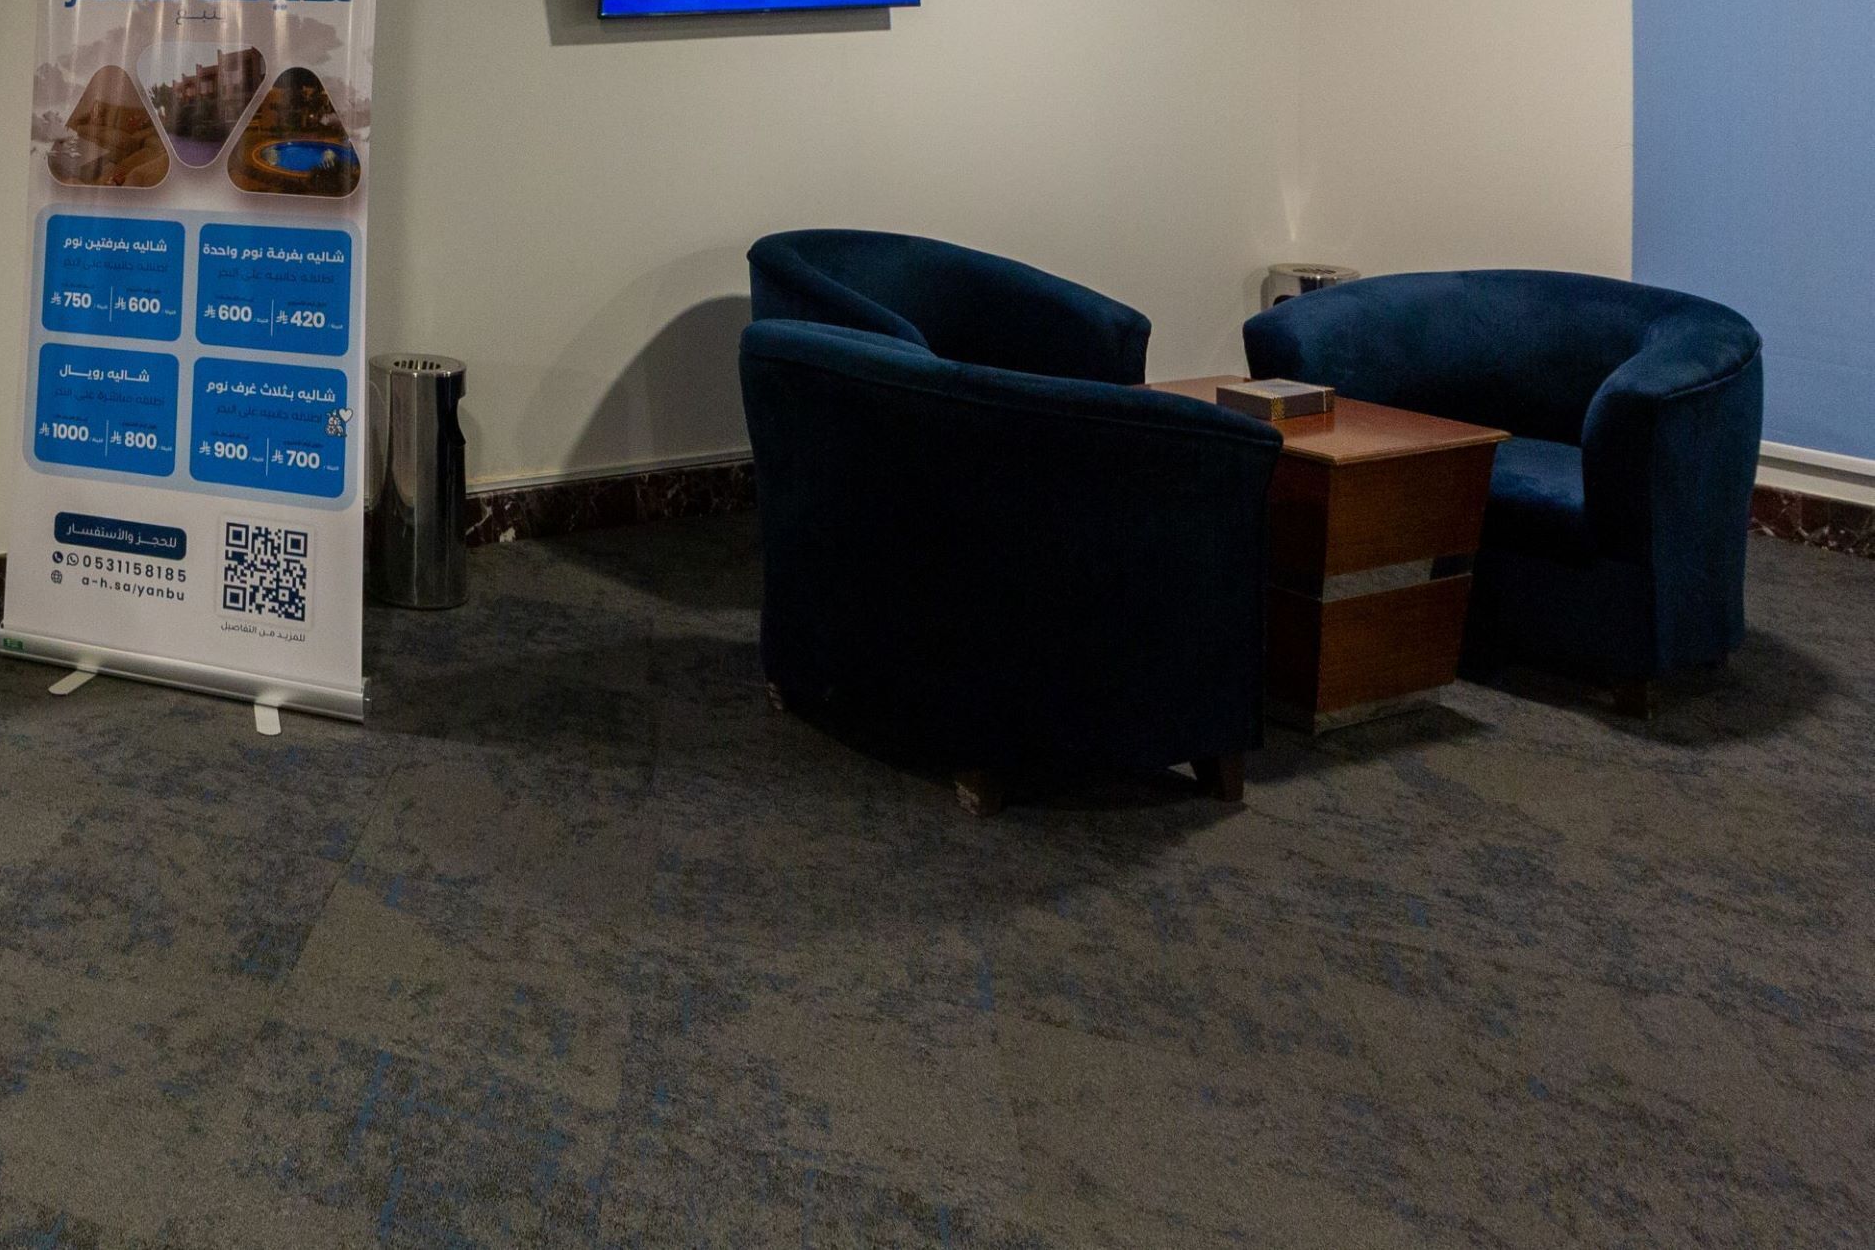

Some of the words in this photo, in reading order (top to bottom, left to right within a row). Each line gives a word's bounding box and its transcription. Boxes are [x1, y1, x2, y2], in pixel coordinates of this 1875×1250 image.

[63, 236, 83, 248] نوم
[85, 237, 130, 252] بغرفتين
[132, 238, 167, 254] شاليه
[202, 243, 238, 259] واحدة
[240, 247, 263, 260] نوم
[266, 246, 303, 263] بغرفة
[306, 250, 345, 264] شاليه
[63, 291, 92, 308] 750
[128, 296, 161, 314] 600
[218, 304, 253, 322] 600
[290, 310, 326, 328] 420
[59, 363, 104, 381] رويال
[107, 368, 150, 382] شاليه
[205, 380, 229, 393] نوم
[230, 381, 257, 396] غرف
[259, 382, 295, 402] بثلاث
[297, 387, 336, 403] شاليه
[52, 422, 89, 442] 1000
[124, 431, 157, 450] 800
[214, 441, 248, 461] 900
[286, 449, 320, 469] 700
[82, 555, 187, 583] 0531158185
[81, 576, 186, 601] a-h.sa/yanbu
[220, 621, 257, 634] التفاصيل
[259, 630, 275, 638] من
[277, 630, 306, 642] للمزيد
